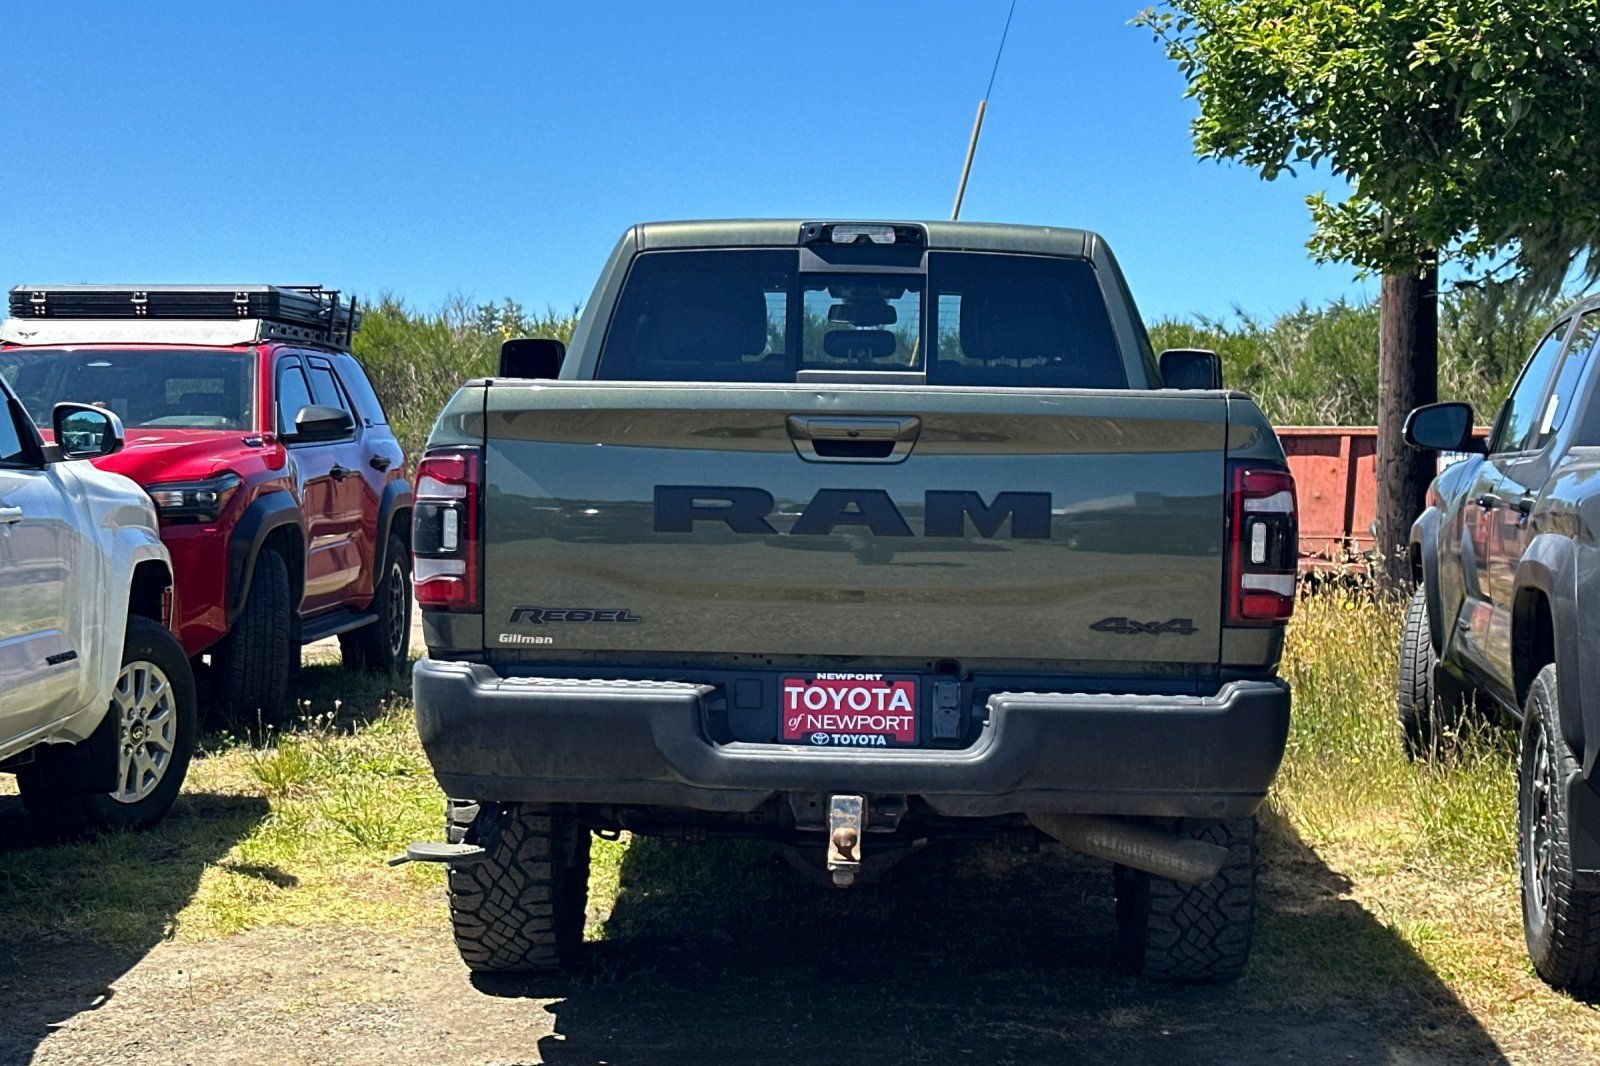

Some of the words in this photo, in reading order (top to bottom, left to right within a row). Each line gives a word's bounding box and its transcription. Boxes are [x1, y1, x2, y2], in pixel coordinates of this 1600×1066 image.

[654, 484, 1052, 539] RAM
[508, 606, 641, 625] REBEL
[498, 633, 553, 644] Gillman
[816, 672, 883, 681] NEWPORT
[784, 686, 913, 711] TOYOTA
[788, 713, 805, 731] of
[807, 714, 913, 731] NEWPORT
[831, 734, 887, 746] TOYOTA
